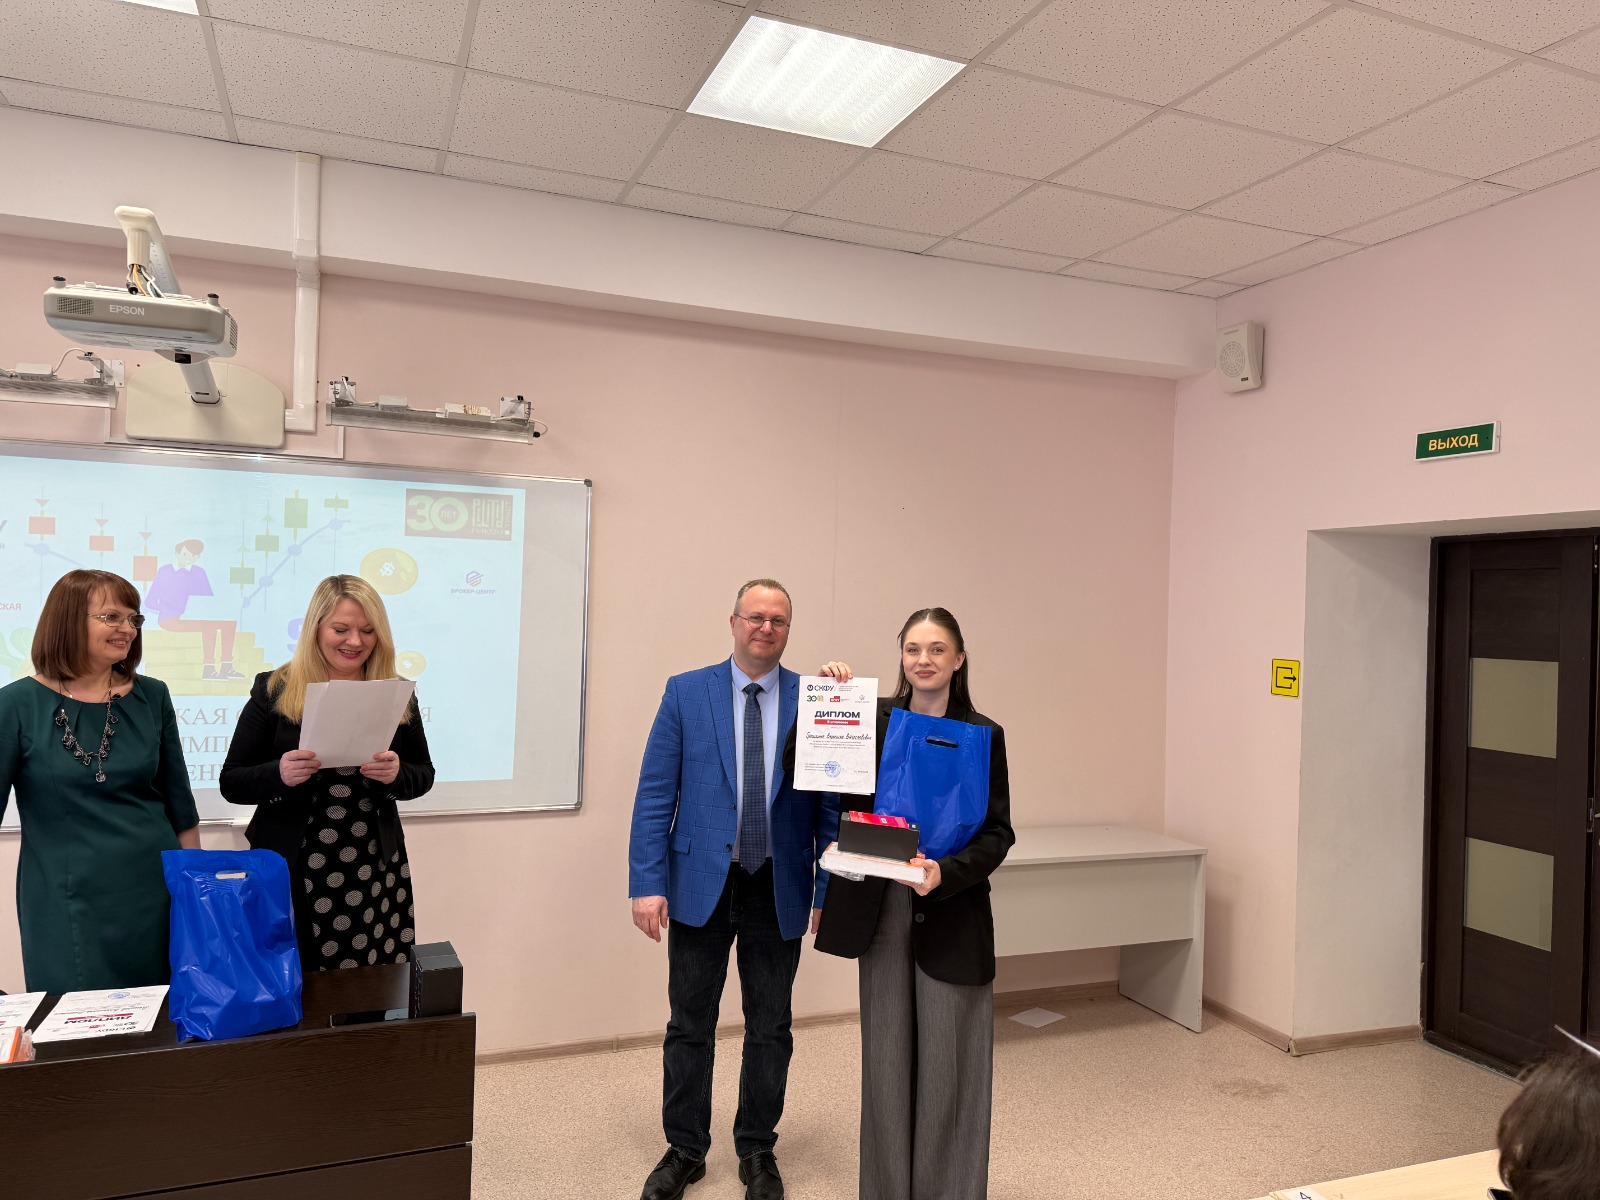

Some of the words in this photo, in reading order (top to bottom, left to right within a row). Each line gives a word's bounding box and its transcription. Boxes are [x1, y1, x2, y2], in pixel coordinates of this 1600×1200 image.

[109, 304, 145, 315] EPSON
[1428, 433, 1479, 451] ВЫХОД
[406, 494, 469, 532] 30
[814, 710, 860, 718] ДИПЛОМ
